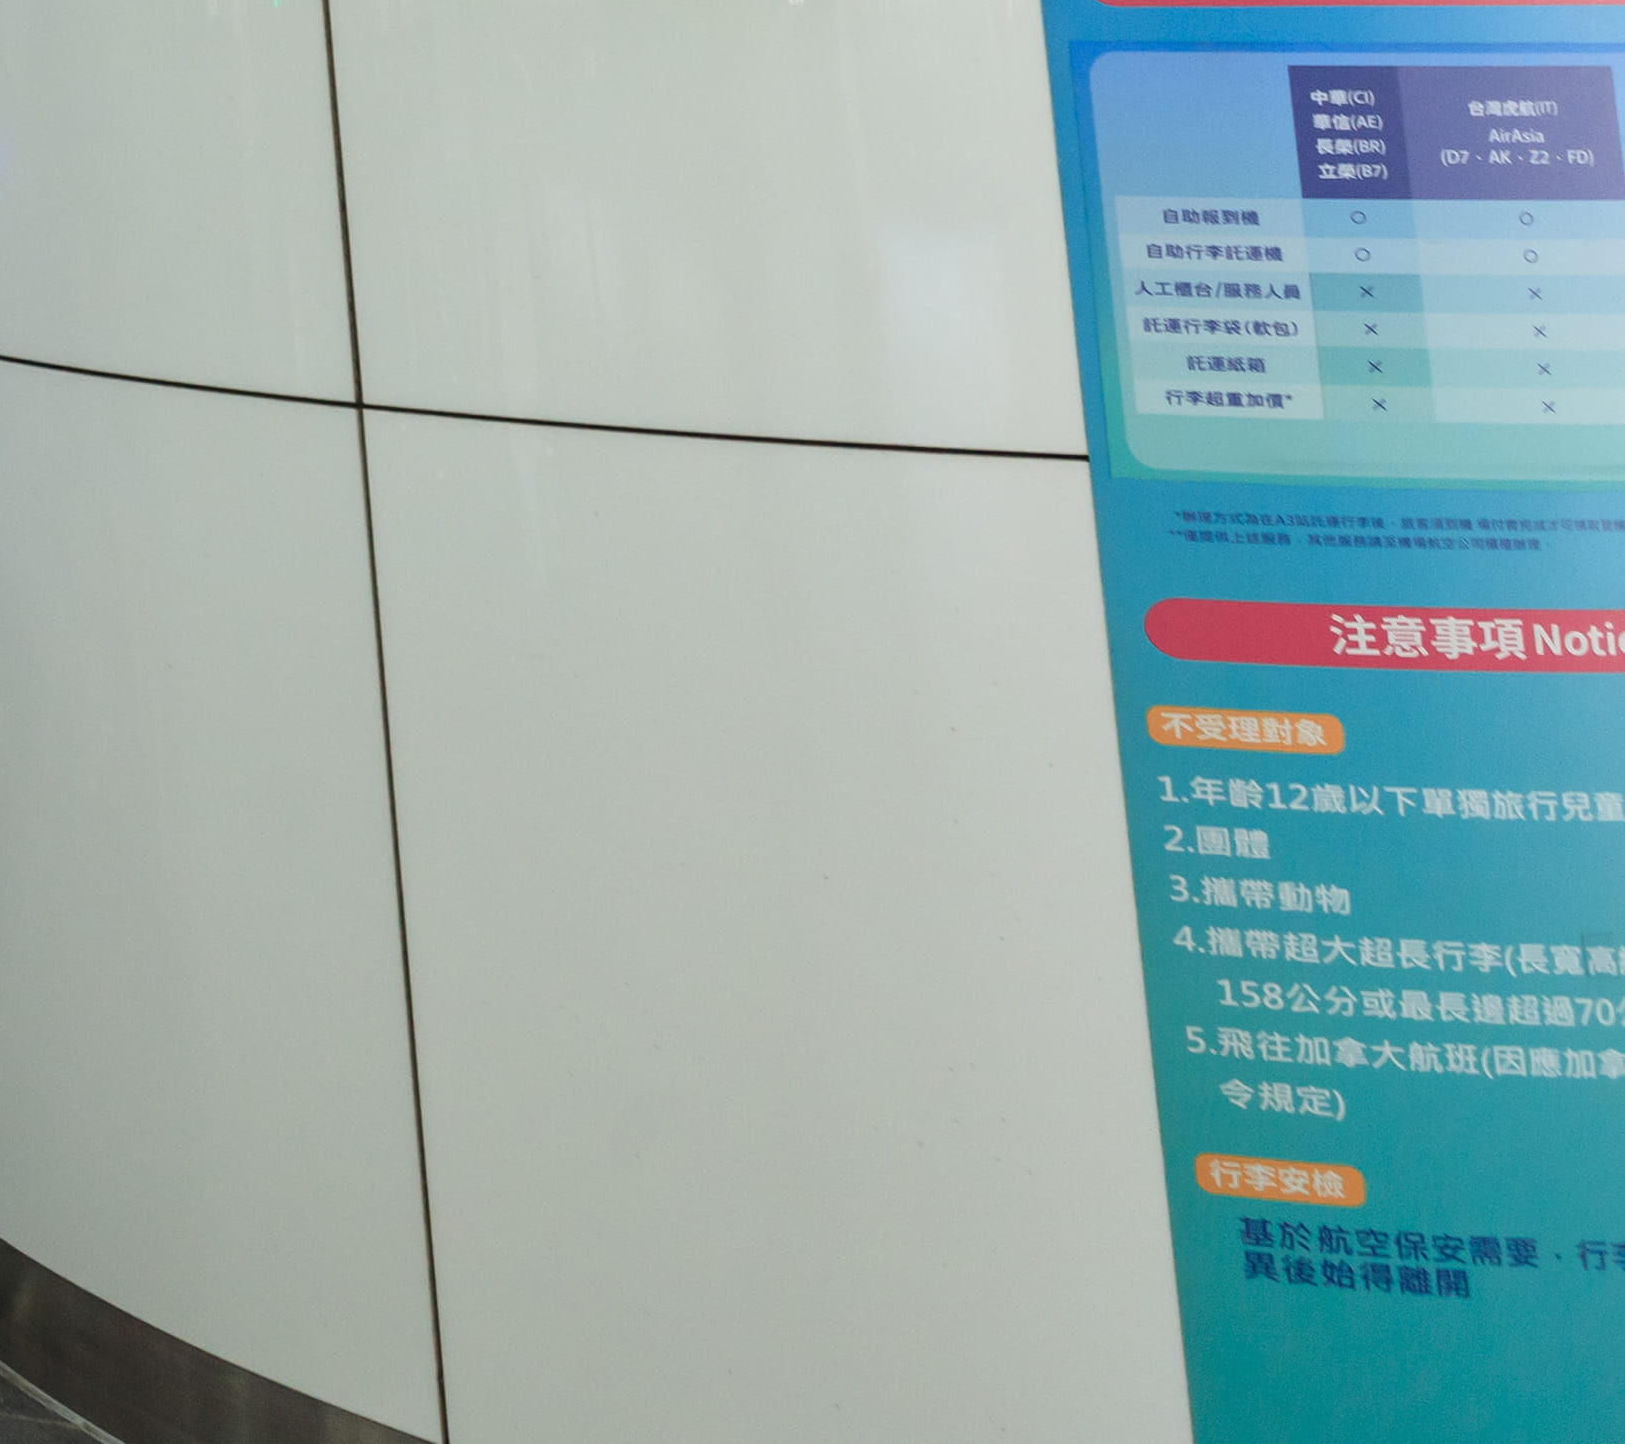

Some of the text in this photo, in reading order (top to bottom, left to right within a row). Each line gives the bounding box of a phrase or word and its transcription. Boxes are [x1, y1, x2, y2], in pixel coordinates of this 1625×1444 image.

[1489, 129, 1545, 144] AirAsia
[1329, 612, 1528, 659] 注意事項
[1161, 711, 1327, 748] 不受理對象
